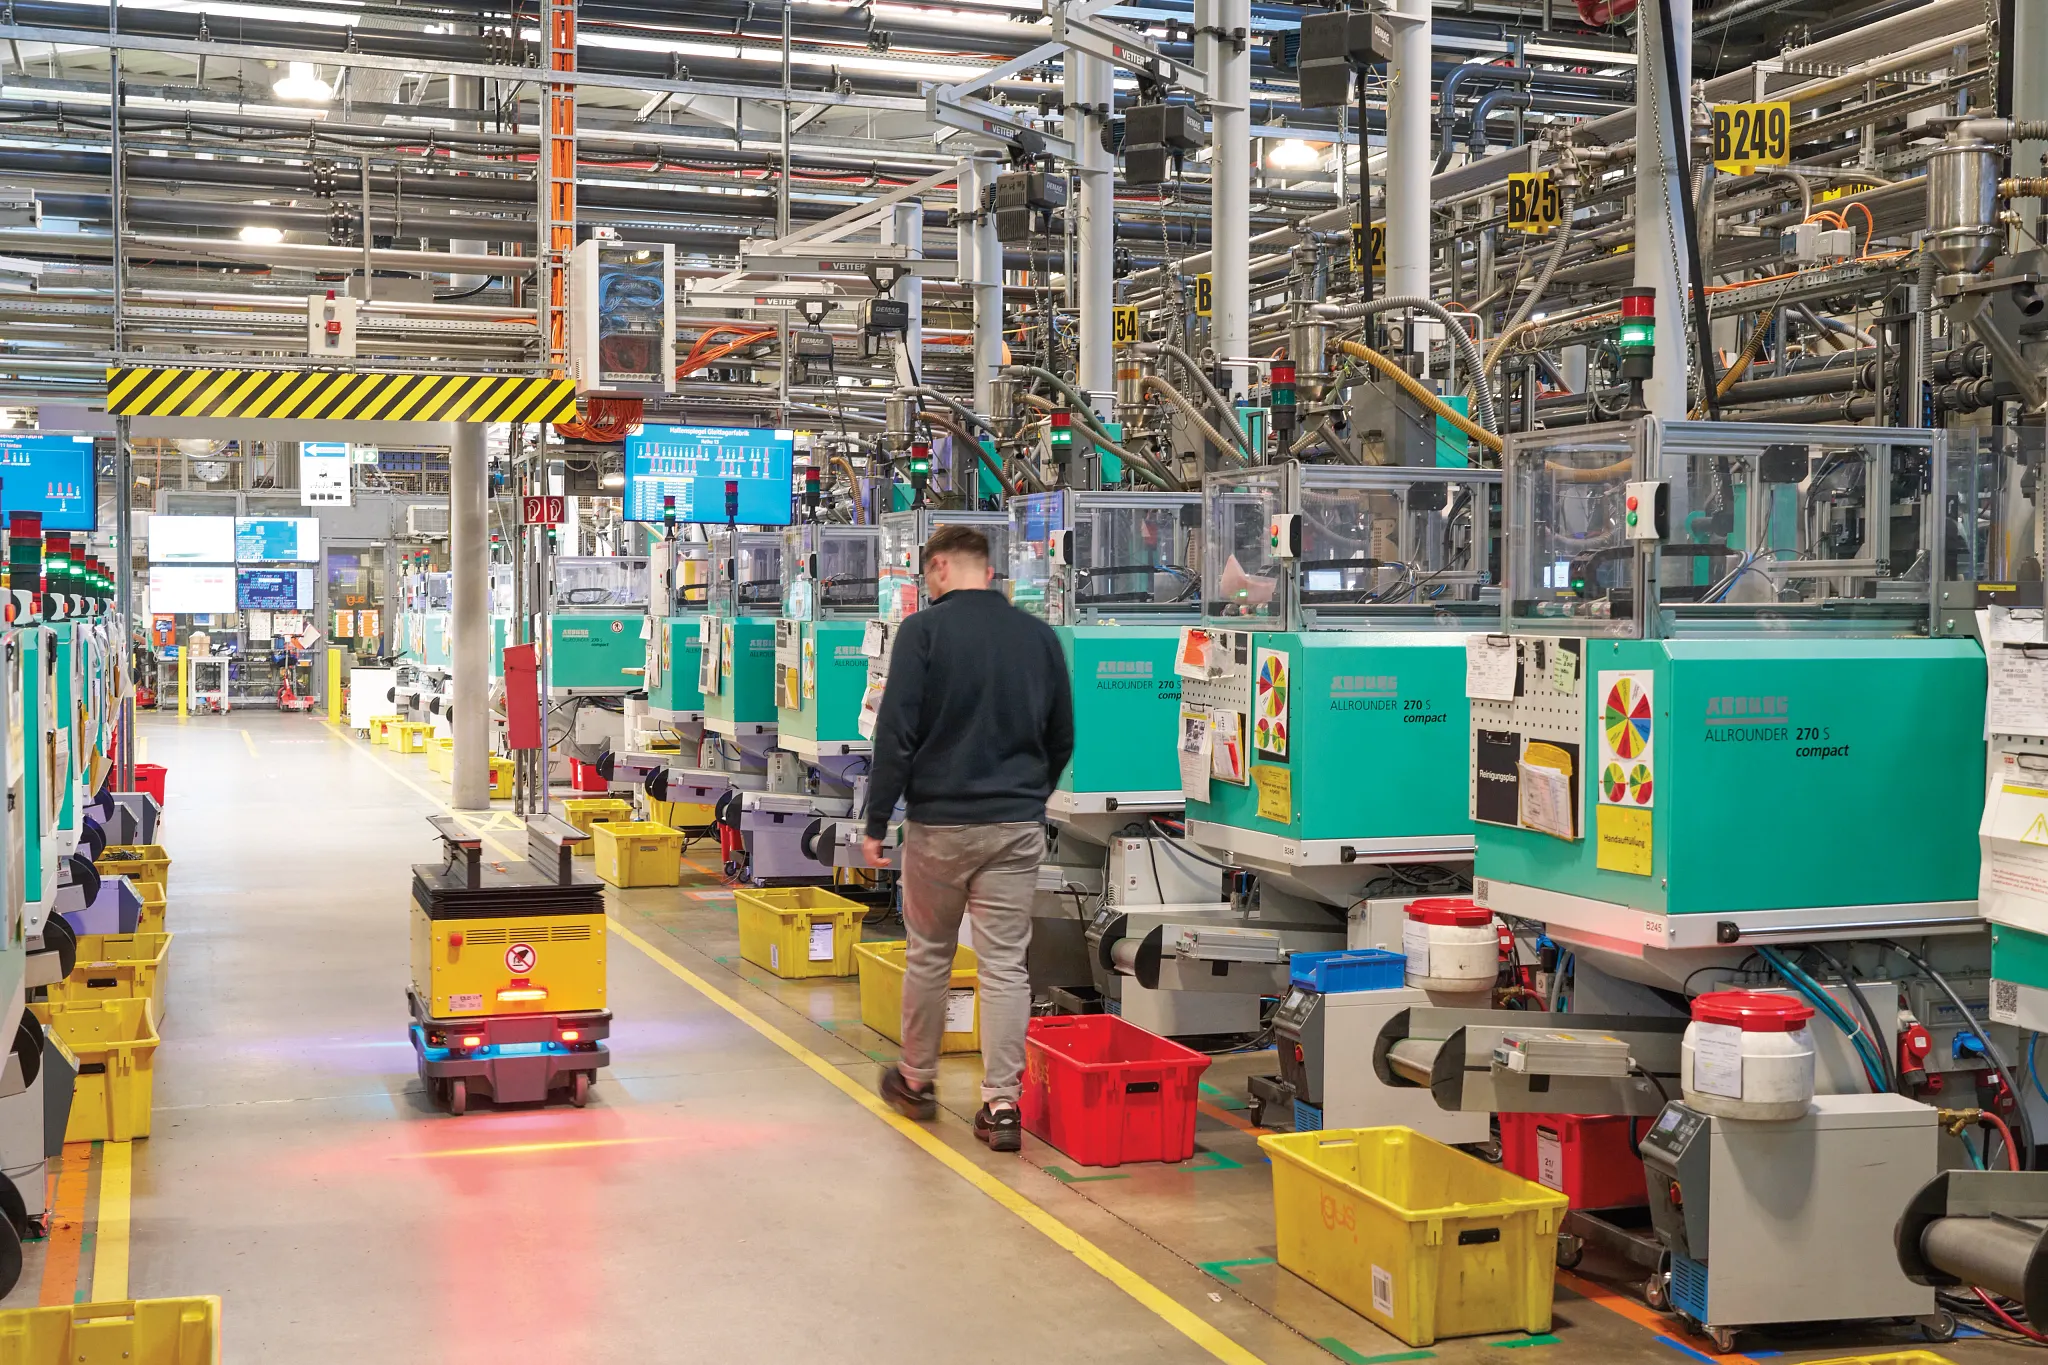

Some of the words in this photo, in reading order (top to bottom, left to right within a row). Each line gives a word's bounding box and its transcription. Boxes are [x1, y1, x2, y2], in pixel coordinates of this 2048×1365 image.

[1374, 25, 1390, 43] DEMAG
[1121, 48, 1145, 66] VETTER
[991, 122, 1014, 138] VETTER
[1186, 116, 1201, 130] DEMAG
[1714, 107, 1786, 161] B249
[1046, 181, 1063, 193] DEMAG
[1509, 178, 1563, 223] B25
[875, 306, 900, 314] DEMAG
[800, 337, 825, 345] DEMAG
[1096, 680, 1153, 690] ALLROUNDER
[1158, 680, 1175, 689] 270
[1329, 700, 1398, 711] ALLROUNDER
[1403, 700, 1423, 710] 270
[1425, 699, 1431, 710] S
[1403, 713, 1447, 725] compact
[1704, 727, 1789, 742] ALLROUNDER
[1796, 727, 1820, 741] 270
[1823, 726, 1831, 741] S
[1796, 744, 1850, 760] compact
[1479, 769, 1517, 783] Reinigungsplan
[1604, 833, 1645, 849] Handauffüllung
[1646, 920, 1662, 933] B245
